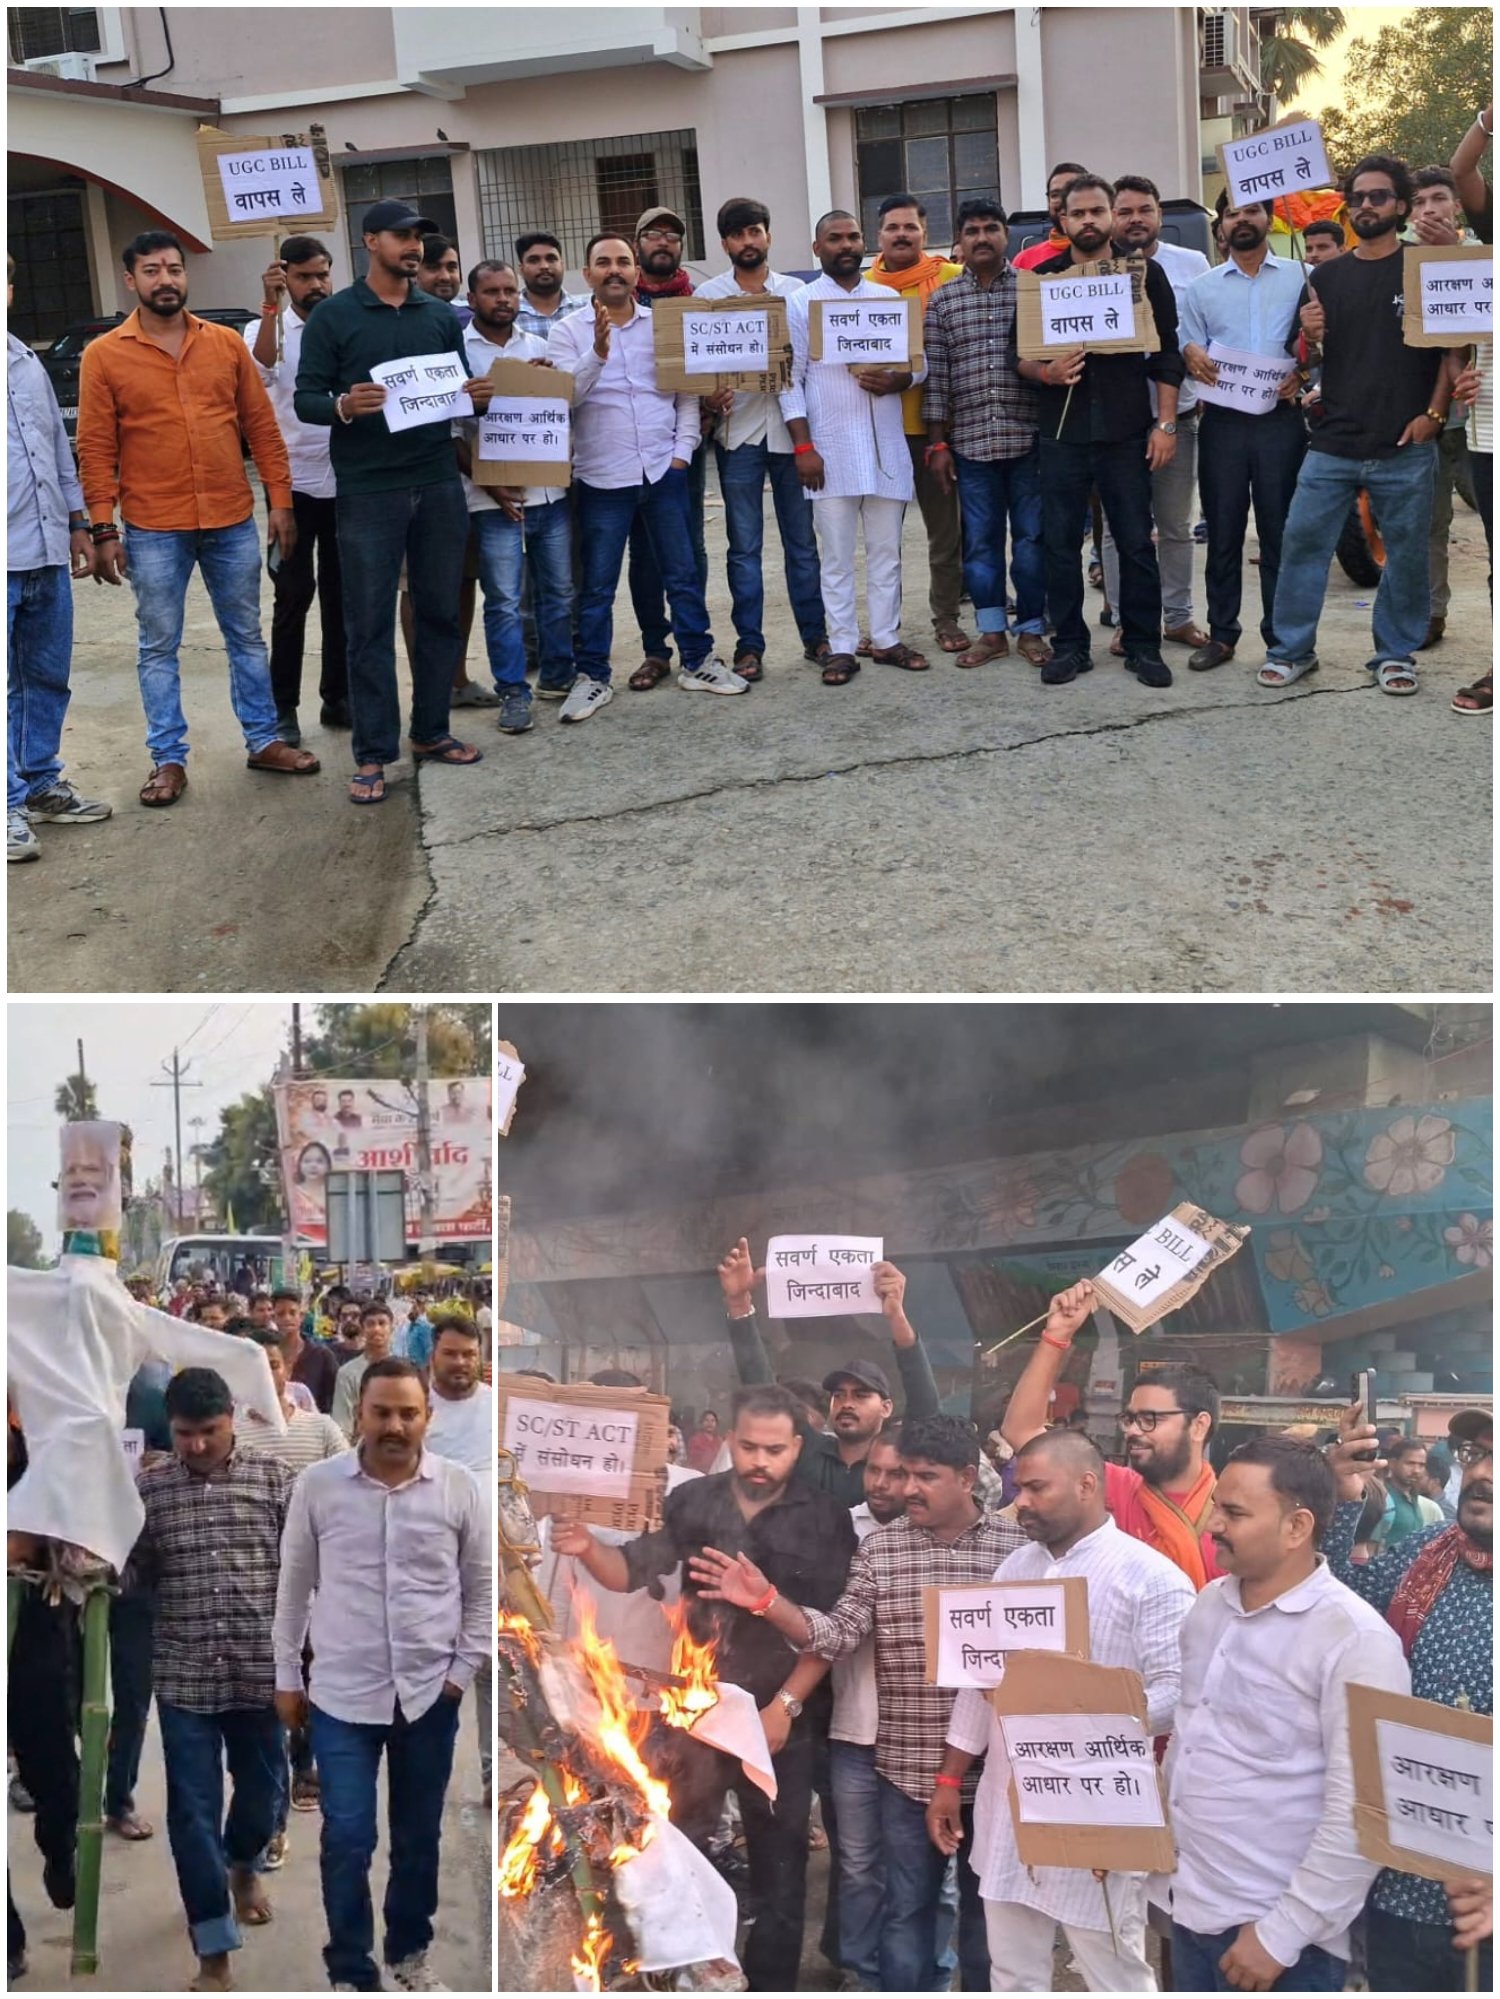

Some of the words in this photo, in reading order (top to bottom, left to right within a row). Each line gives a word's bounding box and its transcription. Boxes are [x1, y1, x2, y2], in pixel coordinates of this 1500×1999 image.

[1233, 142, 1269, 162] UGC
[1272, 130, 1312, 151] BILL
[228, 159, 265, 175] UGC
[270, 156, 307, 174] BILL
[1239, 168, 1285, 195] वापस
[1295, 157, 1312, 180] ले
[234, 189, 280, 210] वापस
[291, 182, 306, 204] ले
[1049, 286, 1083, 301] UGC
[1088, 282, 1124, 297] BILL
[1426, 278, 1473, 292] आरक्षण
[829, 309, 860, 327] सवर्ण
[868, 312, 902, 326] एकता
[1427, 302, 1466, 315] आधार
[690, 321, 731, 336] SC/ST
[736, 320, 765, 334] ACT
[1051, 315, 1093, 334] वापस
[1104, 307, 1119, 329] ले
[691, 341, 699, 356] में
[706, 342, 743, 356] संसोधन
[837, 335, 892, 352] जिन्दाबाद
[382, 365, 418, 389] सवर्ण
[424, 365, 459, 382] एकता
[1242, 385, 1256, 398] पर
[484, 411, 522, 423] आरक्षण
[529, 409, 566, 424] आर्थिक
[484, 432, 516, 445] आधार
[522, 432, 536, 445] पर
[775, 1244, 817, 1267] सवर्ण
[829, 1249, 874, 1265] एकता
[1154, 1227, 1193, 1262] BILL
[1135, 1264, 1161, 1290] ले
[787, 1279, 861, 1301] जिन्दाबाद
[517, 1414, 579, 1437] SC/ST
[585, 1423, 631, 1443] ACT
[537, 1447, 593, 1469] संसोधन
[950, 1601, 991, 1629] सवर्ण
[1004, 1606, 1055, 1629] एकता
[1015, 1741, 1075, 1760] आरक्षण
[1085, 1735, 1146, 1759] आर्थिक
[1022, 1777, 1071, 1795] आधार
[1081, 1777, 1102, 1795] पर
[1391, 1755, 1482, 1795] आरक्षण
[1394, 1797, 1470, 1835] आधार
